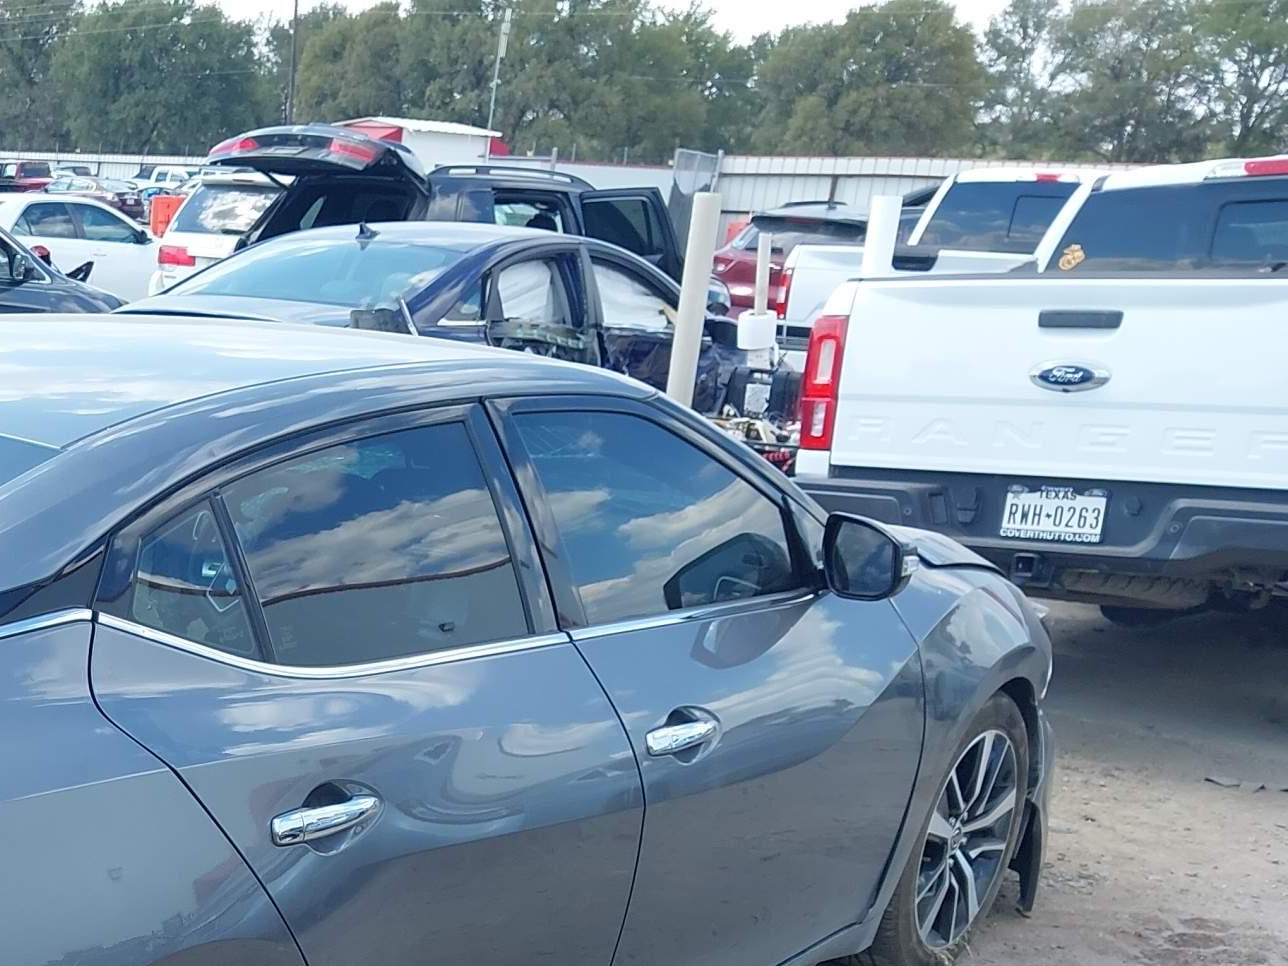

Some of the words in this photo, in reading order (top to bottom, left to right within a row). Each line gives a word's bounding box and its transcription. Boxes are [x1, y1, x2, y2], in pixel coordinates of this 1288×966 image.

[1048, 367, 1084, 383] Ford
[1039, 489, 1077, 501] TEXAS
[1000, 528, 1100, 543] COVERTHUTTO.COM
